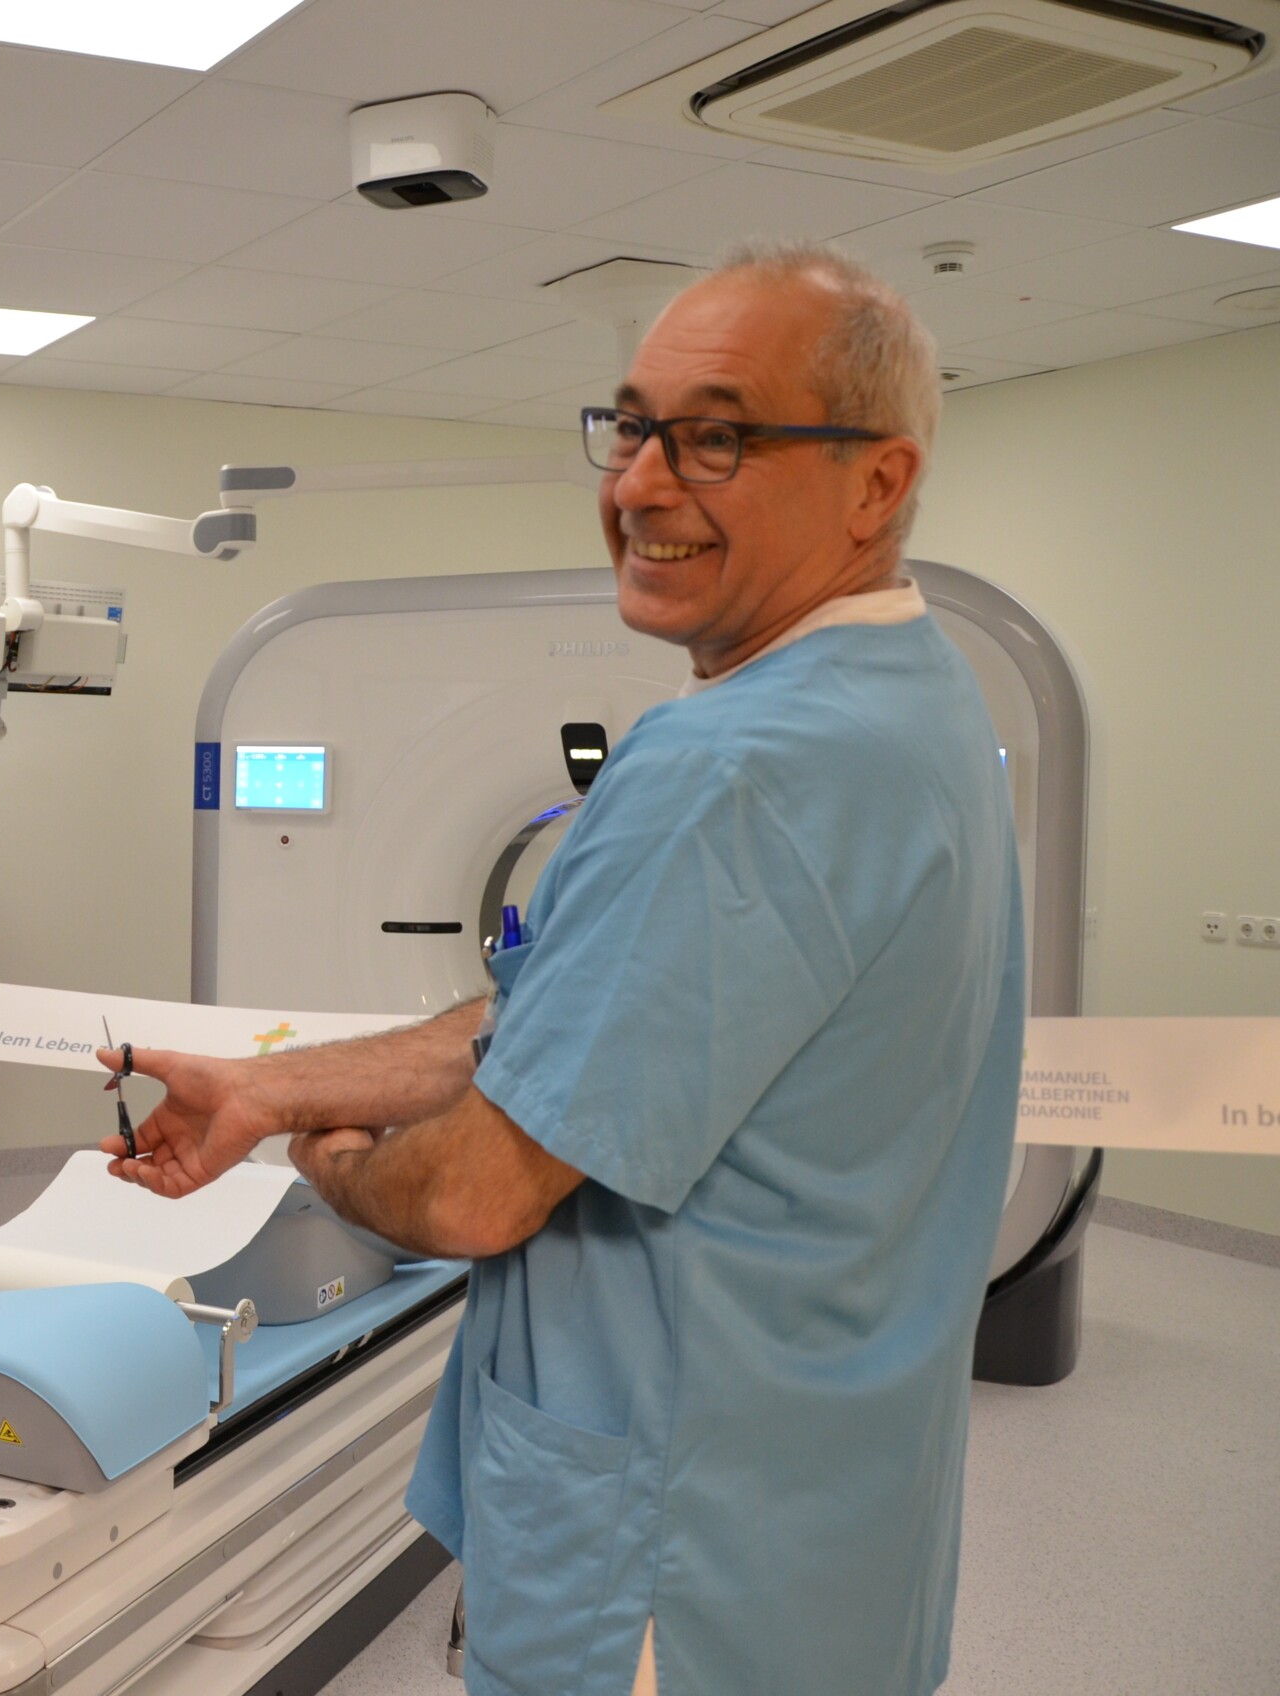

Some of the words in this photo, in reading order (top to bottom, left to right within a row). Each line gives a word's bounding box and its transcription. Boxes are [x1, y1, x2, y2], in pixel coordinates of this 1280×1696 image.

[548, 640, 631, 656] PHILIPS
[202, 751, 212, 782] 5300
[202, 785, 212, 801] CT
[35, 1036, 93, 1054] Leben
[1024, 1070, 1113, 1086] MMANUEL
[1019, 1087, 1131, 1104] ALBERTINEN
[1020, 1103, 1103, 1121] DIAKONIE
[1222, 1103, 1248, 1126] In
